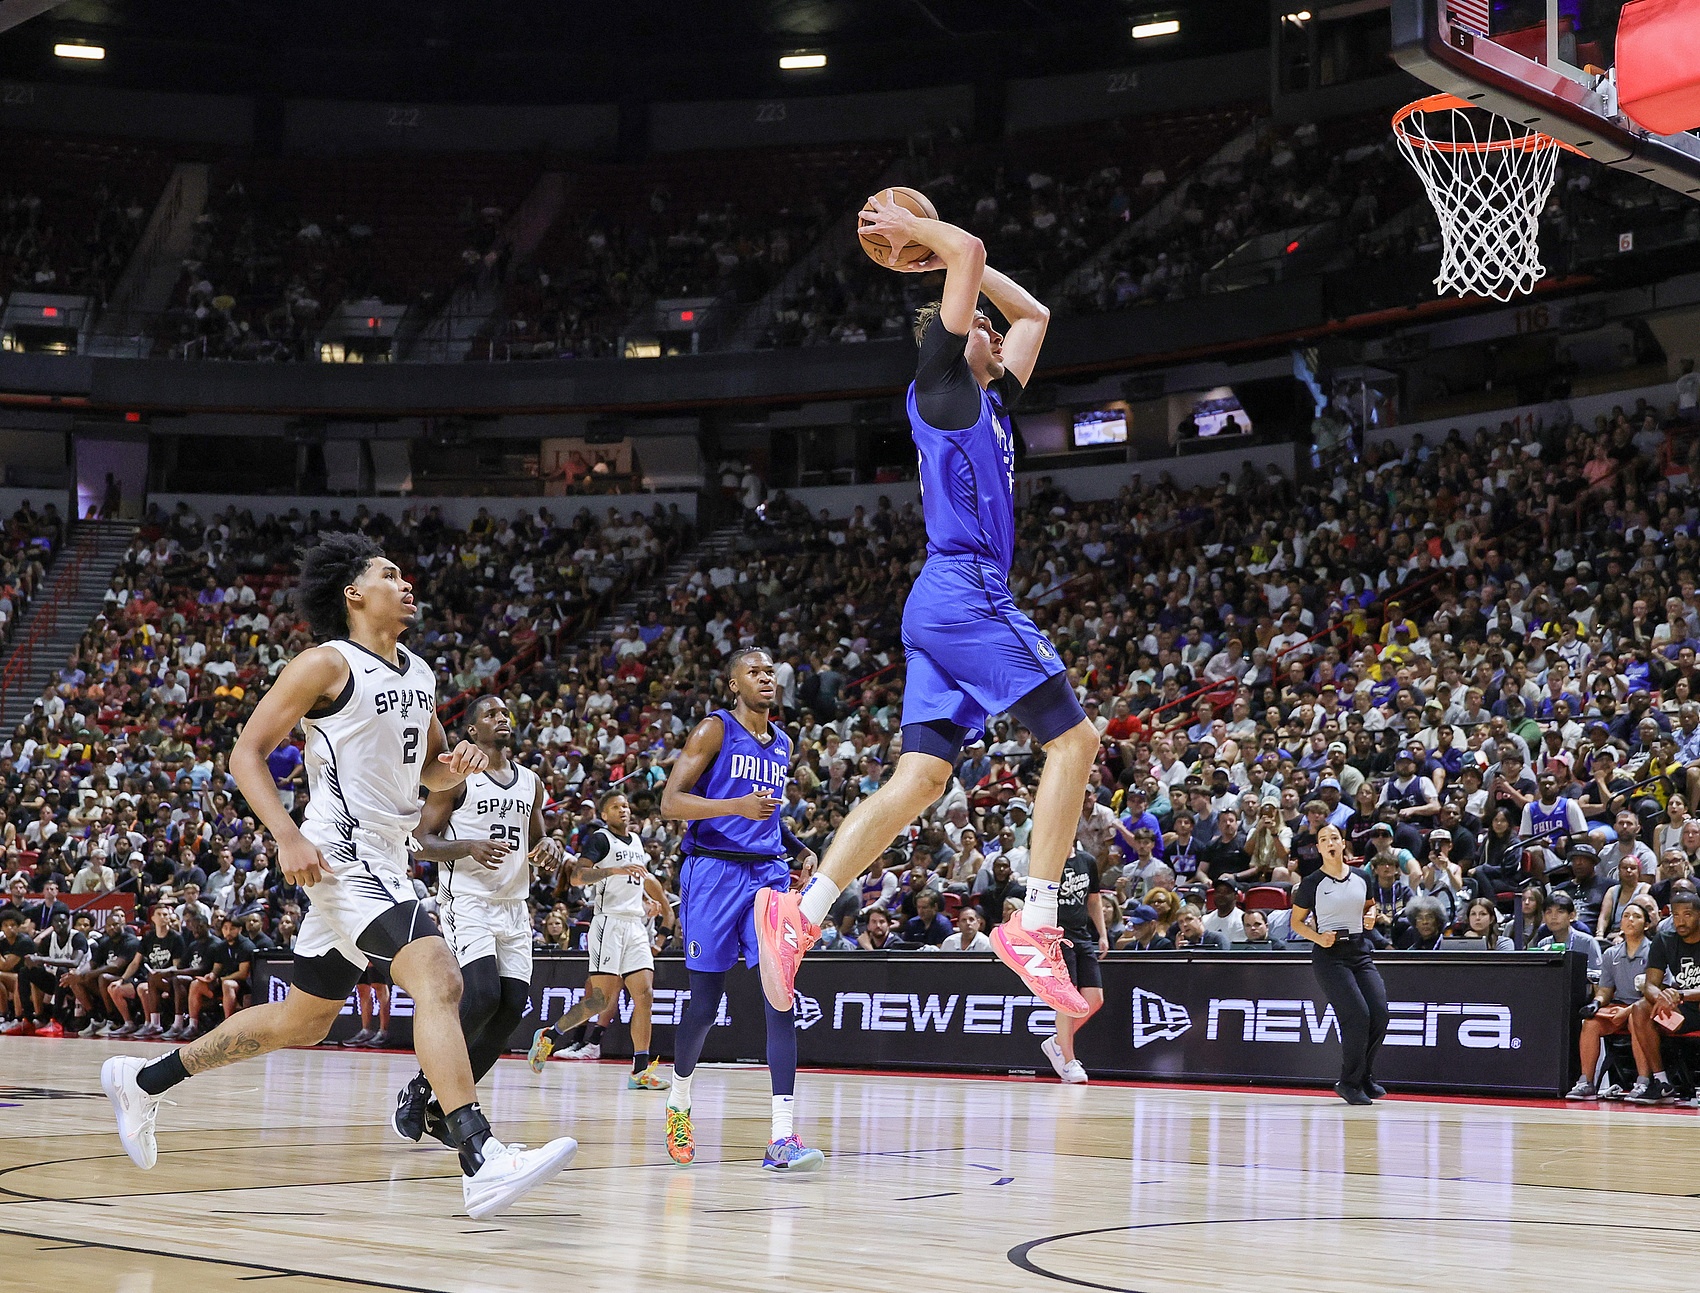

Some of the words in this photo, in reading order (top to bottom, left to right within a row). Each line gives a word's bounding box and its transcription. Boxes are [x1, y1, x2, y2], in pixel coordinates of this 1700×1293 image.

[1460, 34, 1465, 46] 5
[388, 107, 420, 126] 222
[755, 103, 786, 121] 223
[1621, 235, 1631, 249] 6
[375, 689, 434, 718] SPURS
[403, 728, 418, 764] 2
[731, 754, 787, 788] DALLAS
[477, 798, 532, 818] SPURS
[490, 824, 521, 851] 25
